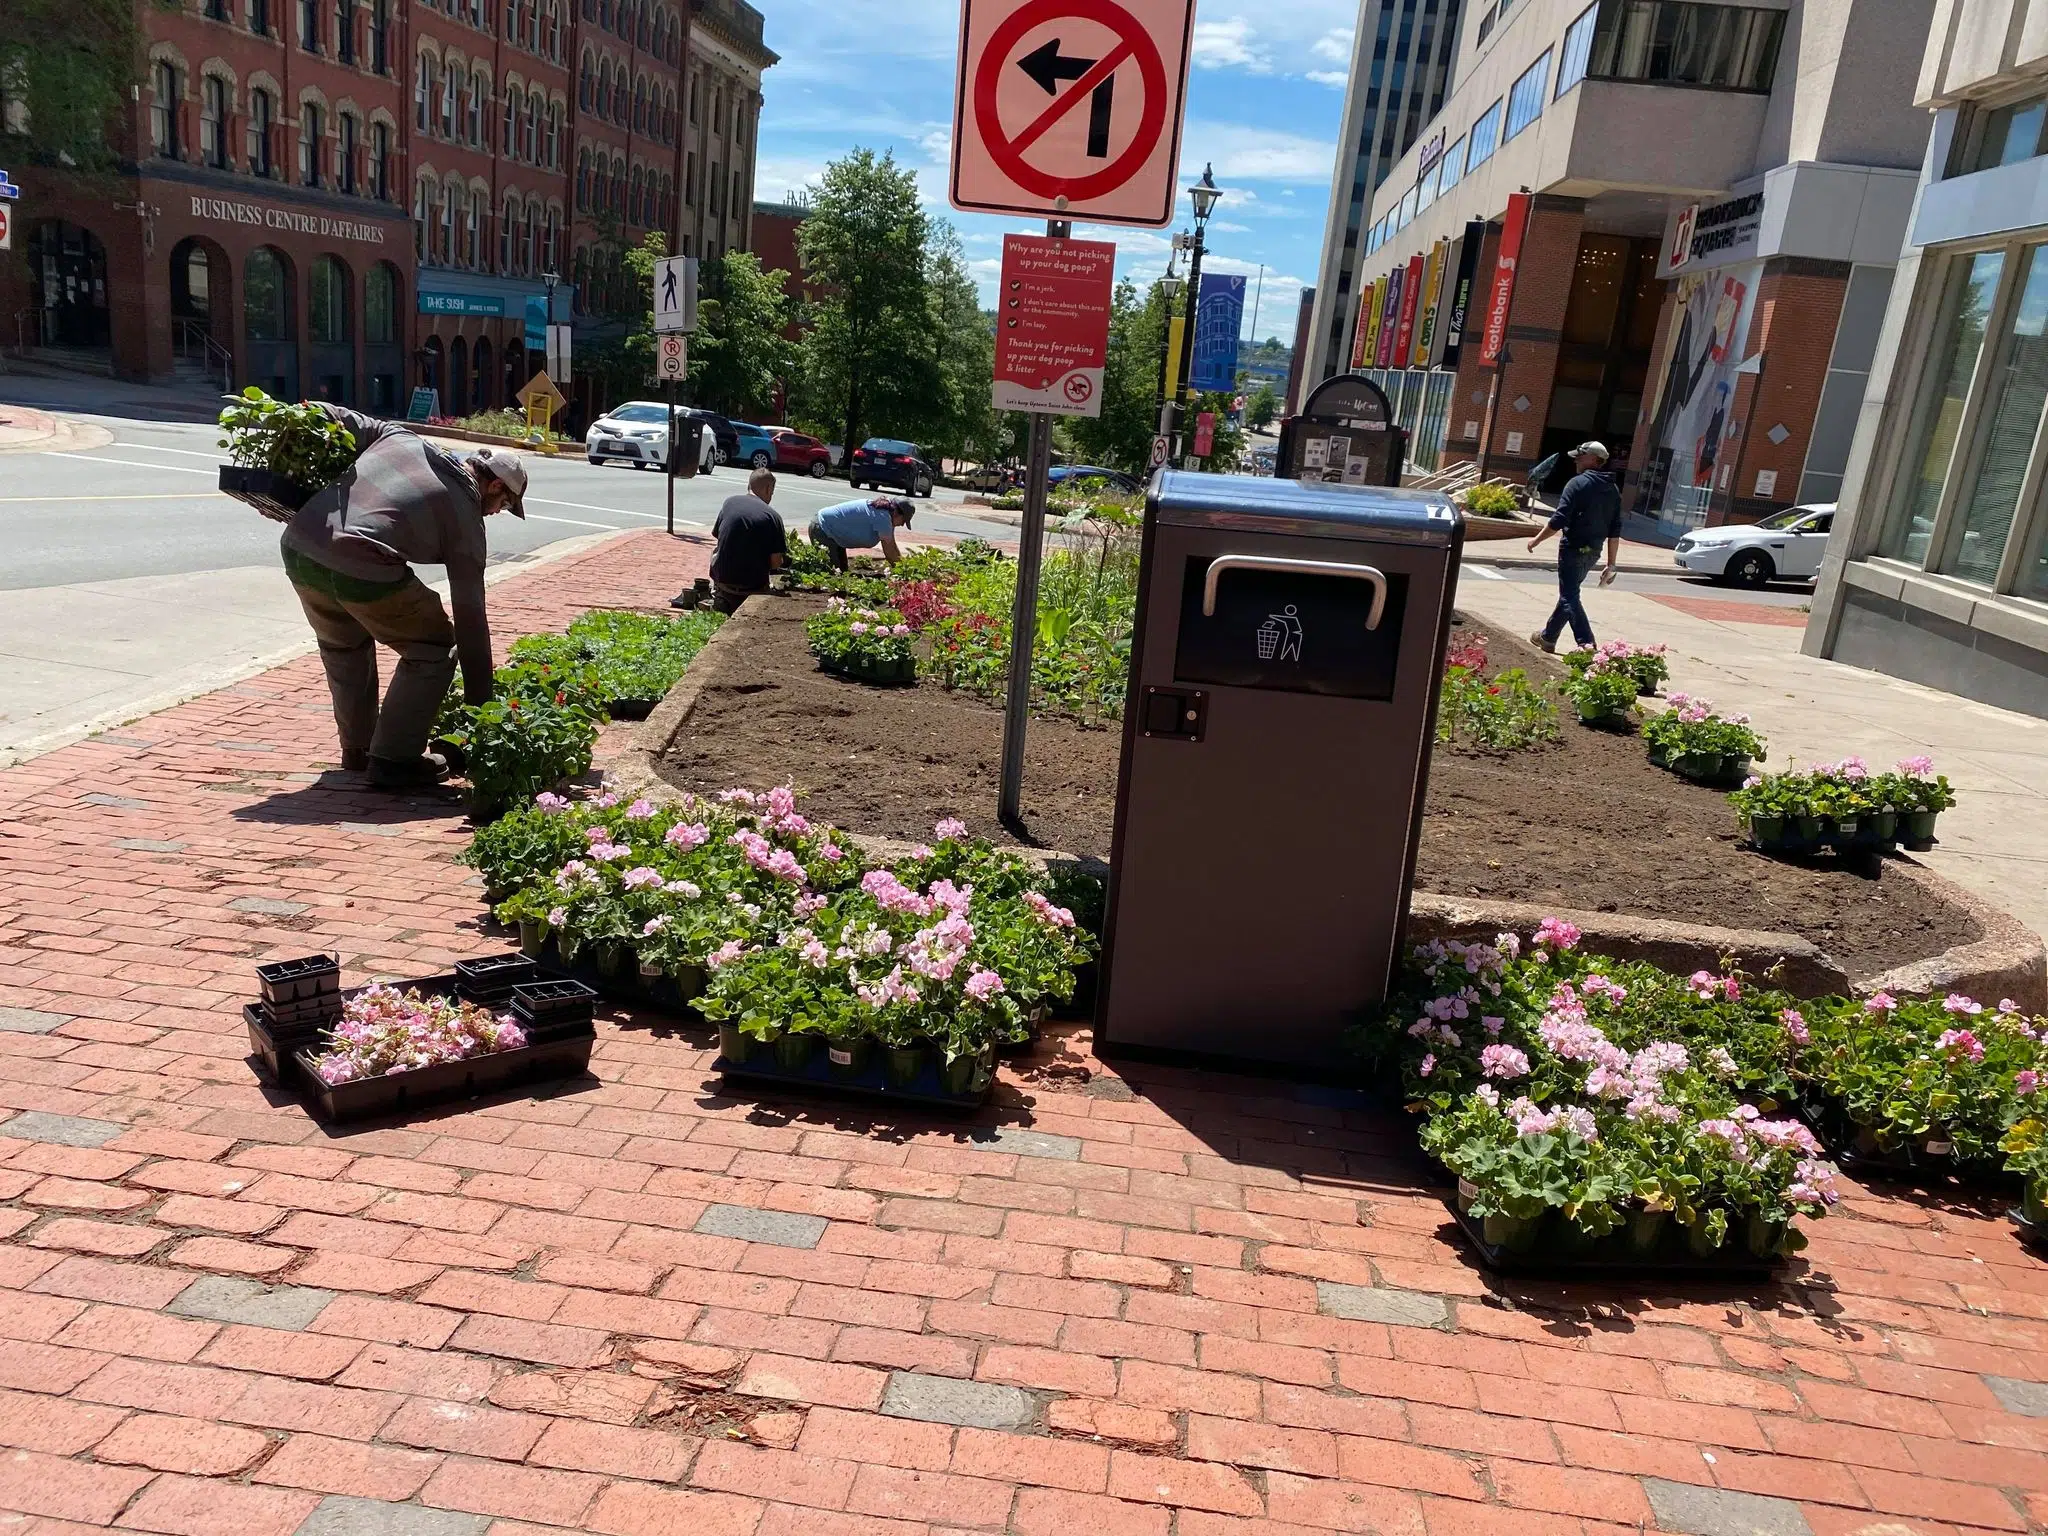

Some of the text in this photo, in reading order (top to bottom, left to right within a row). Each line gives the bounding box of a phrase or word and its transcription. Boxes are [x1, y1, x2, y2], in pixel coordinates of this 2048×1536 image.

[191, 196, 384, 244] BUSINESS CENTRE D'AFFAIRES
[1009, 242, 1028, 256] Why
[1045, 247, 1060, 258] you
[1062, 249, 1076, 257] not
[1079, 250, 1110, 263] picking
[1020, 260, 1097, 274] up your dog poop?
[1025, 283, 1035, 291] I'm
[446, 298, 465, 310] SUSHI
[1028, 298, 1043, 306] don't
[1060, 301, 1077, 309] about
[1483, 278, 1510, 359] Scotiabank
[1008, 338, 1095, 357] Thank you for picking
[1007, 353, 1074, 367] up your dog poop
[1006, 363, 1036, 374] & litter
